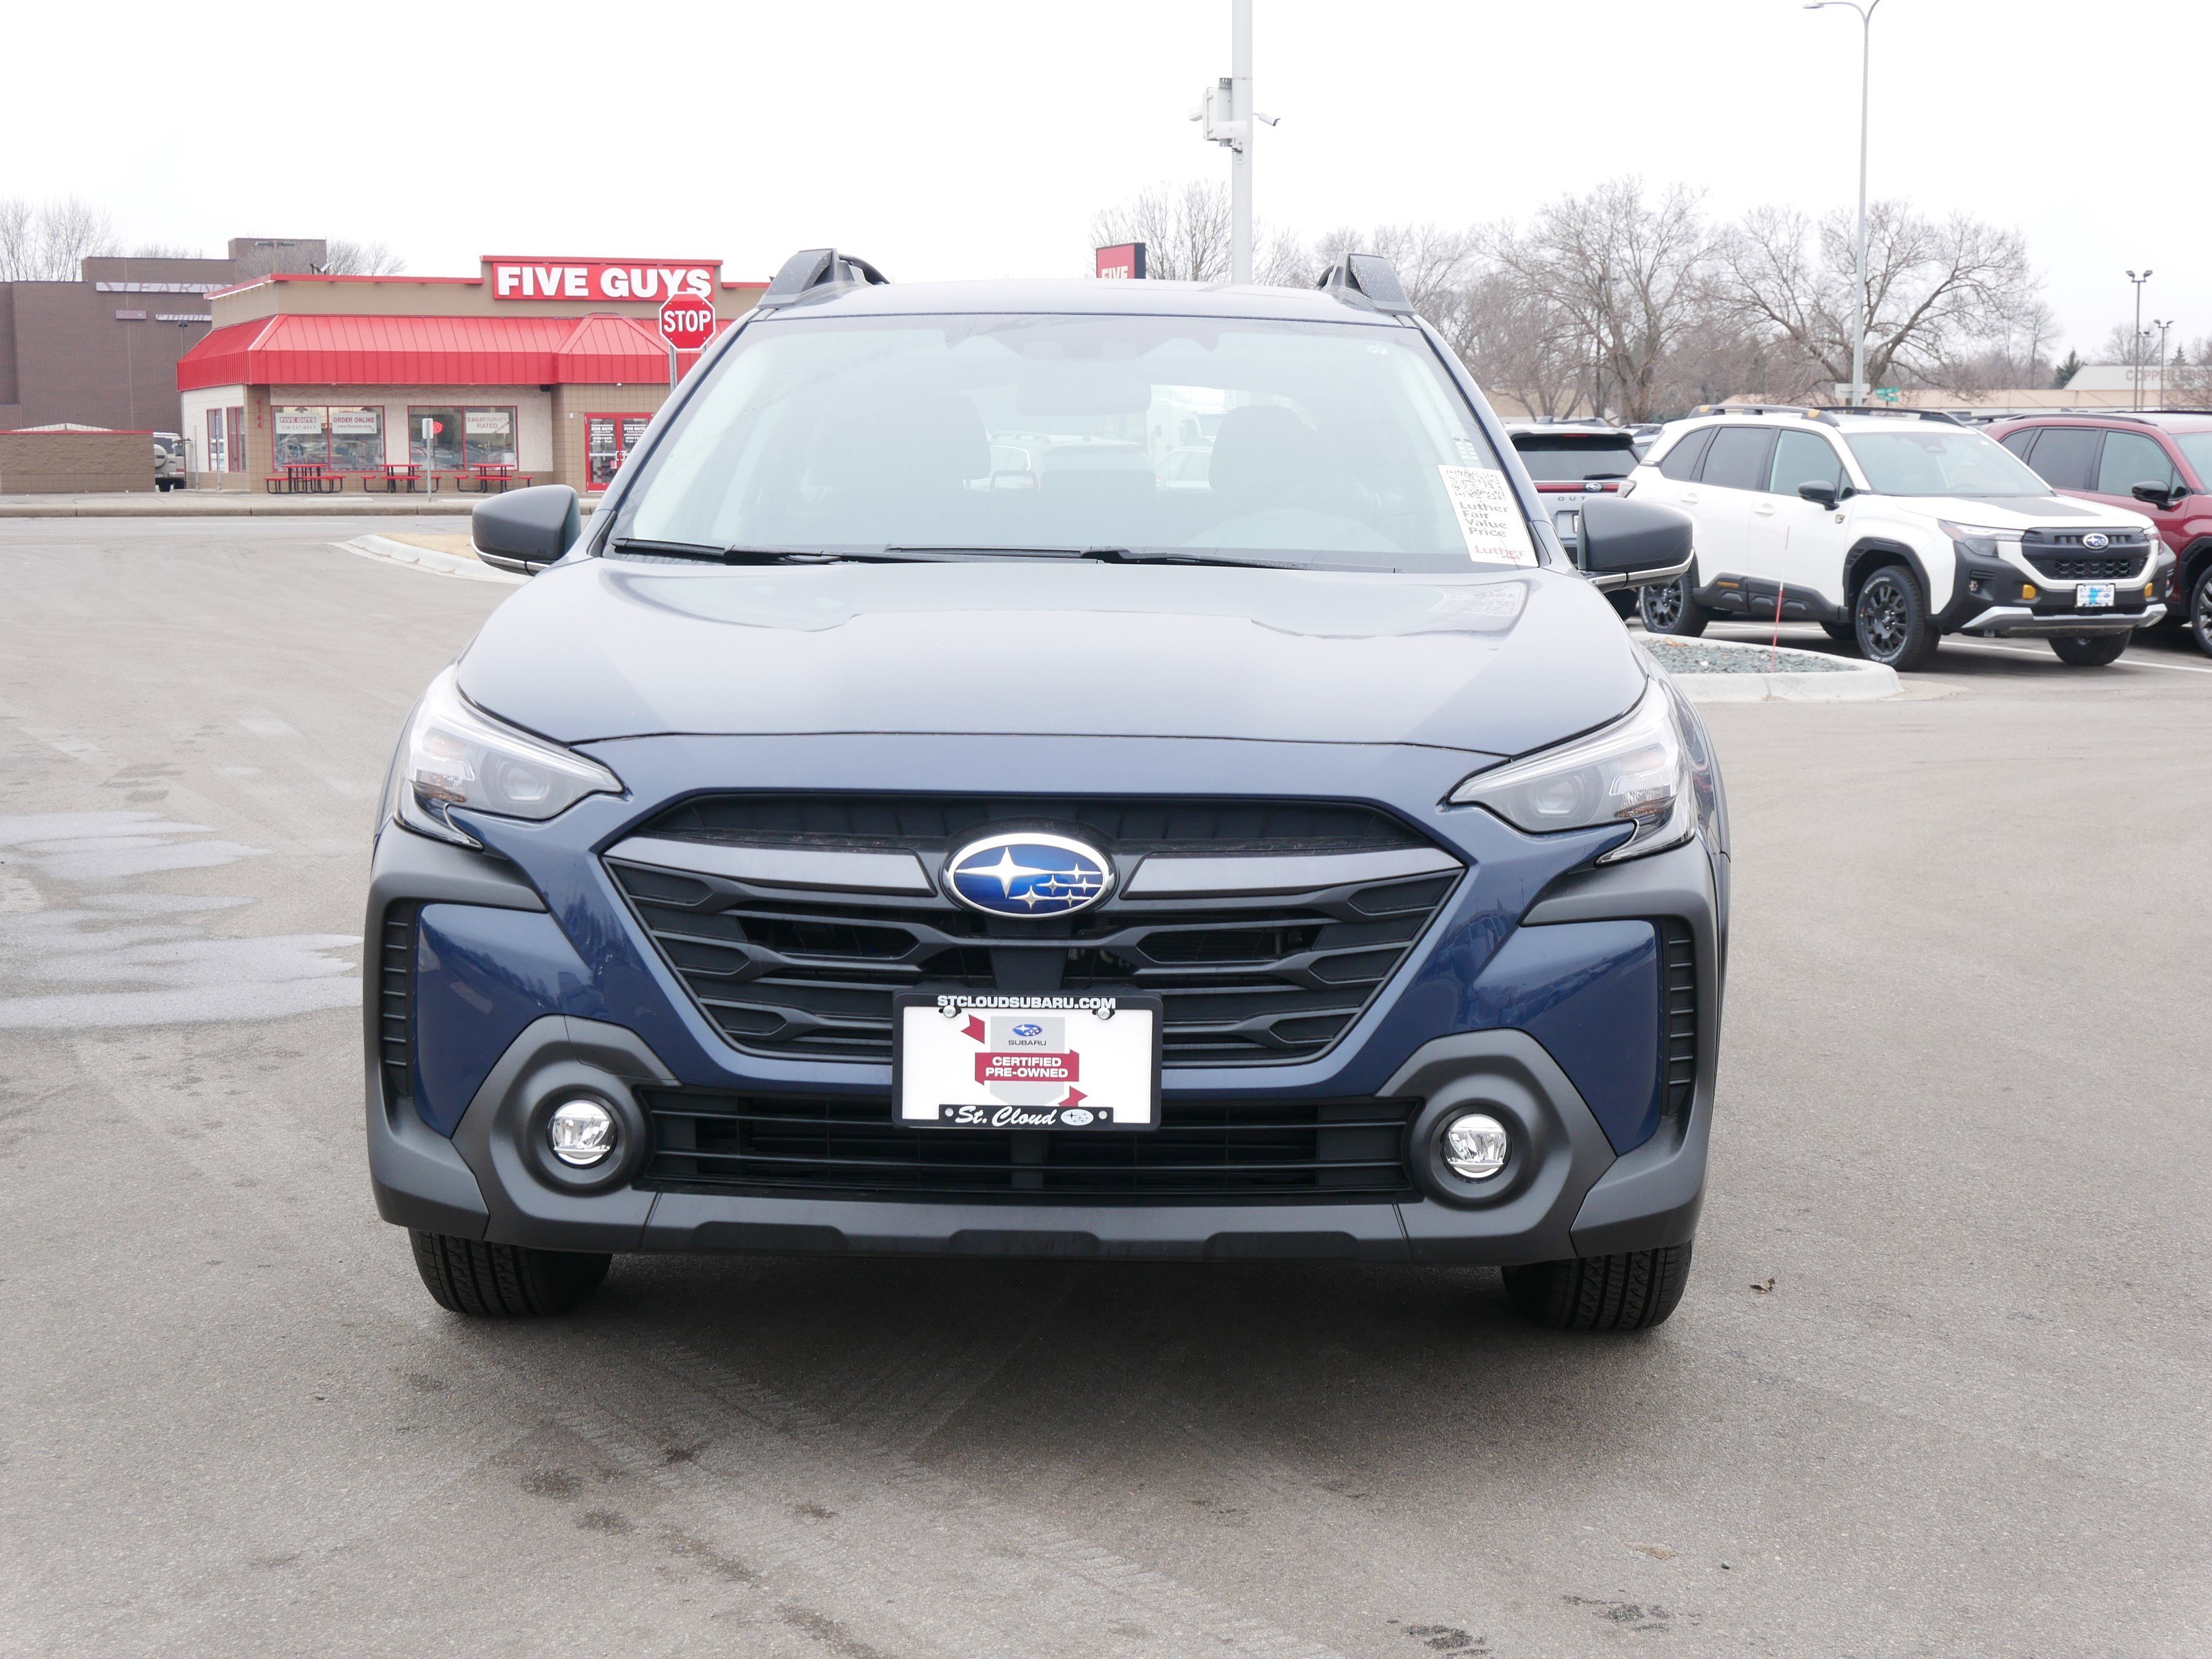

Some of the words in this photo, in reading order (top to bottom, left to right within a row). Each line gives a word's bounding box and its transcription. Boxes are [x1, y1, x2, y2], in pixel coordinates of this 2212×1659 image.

[498, 266, 589, 296] FIVE
[600, 268, 712, 298] GUYS
[663, 309, 711, 333] STOP
[1459, 502, 1508, 512] Luther
[1463, 510, 1489, 519] Fair
[1465, 518, 1508, 528] Value
[1469, 527, 1507, 537] Price
[1474, 545, 1524, 556] Luther
[937, 995, 1116, 1009] STCLOUDSUBARU.COM
[992, 1056, 1062, 1067] CERTIFIED
[986, 1067, 1069, 1078] PRE-OWNED
[955, 1105, 988, 1124] St.
[991, 1105, 1057, 1127] Cloud
